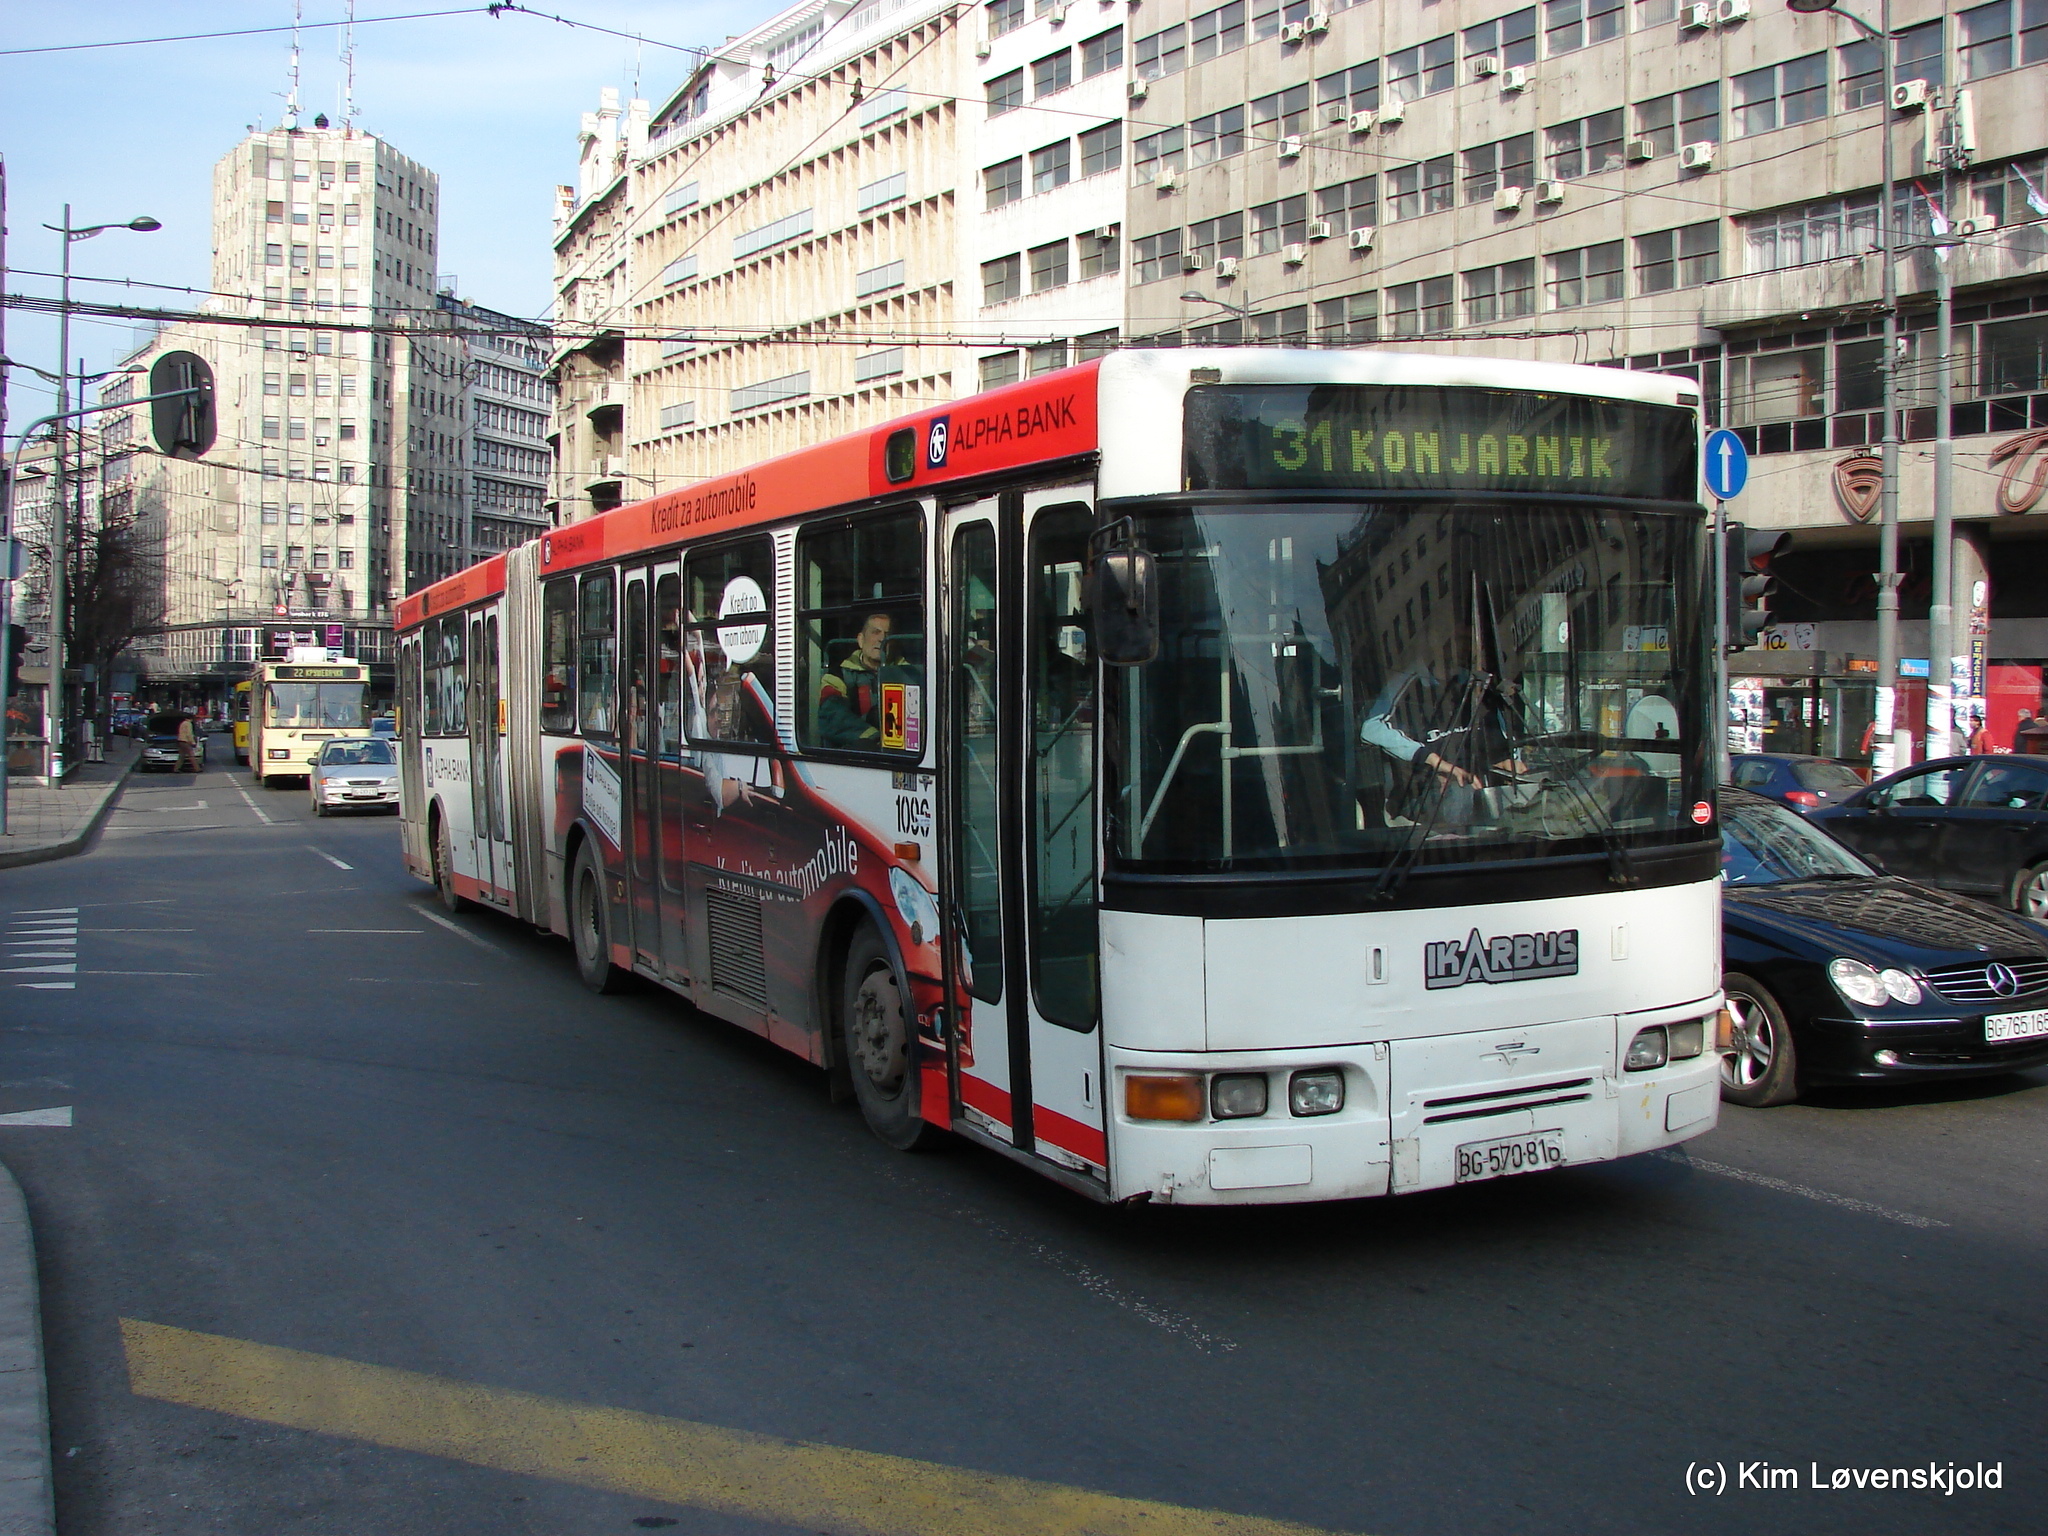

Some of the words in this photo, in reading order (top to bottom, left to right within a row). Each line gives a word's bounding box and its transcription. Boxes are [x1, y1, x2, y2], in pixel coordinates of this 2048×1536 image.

[952, 413, 1013, 453] ALPHA
[1017, 394, 1076, 438] BANK
[1273, 419, 1333, 471] 31
[1351, 430, 1612, 478] KONJARNIK
[651, 496, 679, 535] Kredit
[680, 500, 692, 527] za
[694, 473, 756, 523] automobile
[730, 592, 749, 613] Kredit
[724, 632, 739, 647] mom
[293, 668, 304, 677] 22
[435, 758, 452, 780] ALPHA
[452, 759, 470, 782] BANK
[776, 825, 858, 903] automobile
[1426, 928, 1578, 989] IKARBUS
